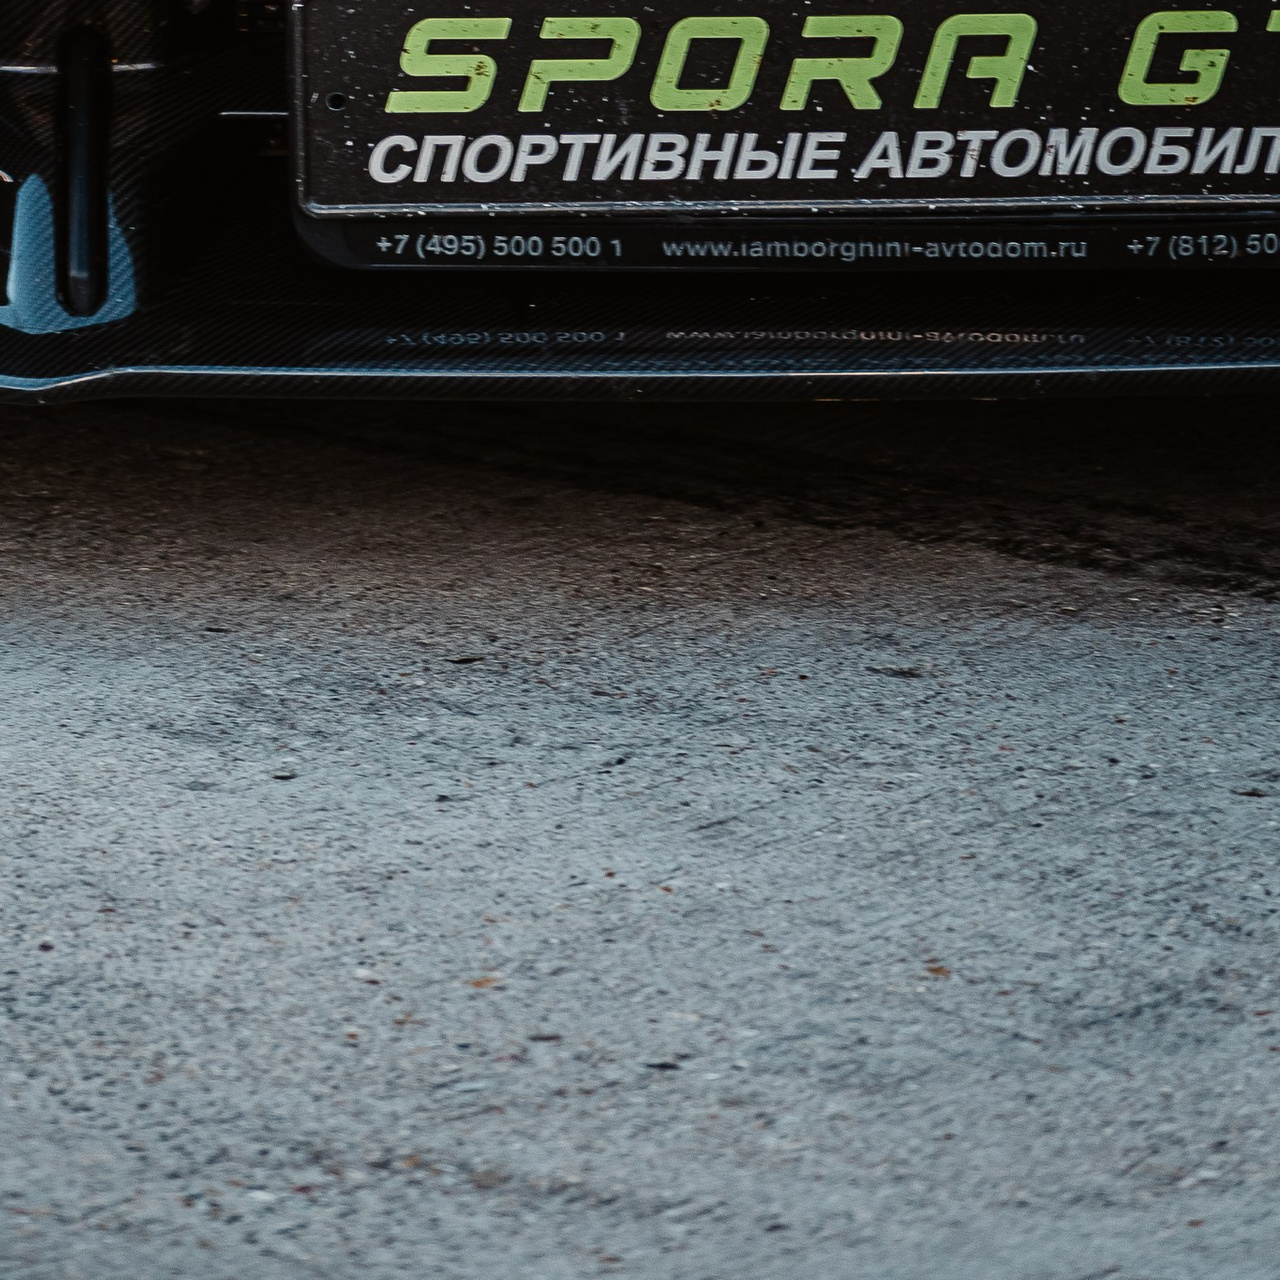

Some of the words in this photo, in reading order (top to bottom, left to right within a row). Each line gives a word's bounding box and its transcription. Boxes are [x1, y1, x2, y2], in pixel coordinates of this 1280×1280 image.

[384, 13, 1038, 114] SPORA
[1117, 10, 1280, 106] G
[367, 131, 846, 185] СПОРТИВНЫЕ
[854, 126, 1280, 179] АВТОМОБИЛ
[376, 234, 410, 256] +7
[416, 234, 487, 260] (495)
[493, 236, 544, 257] 500
[550, 237, 602, 257] 500
[609, 238, 623, 256] 1
[1127, 236, 1161, 257] +7
[1169, 234, 1237, 260] (812)
